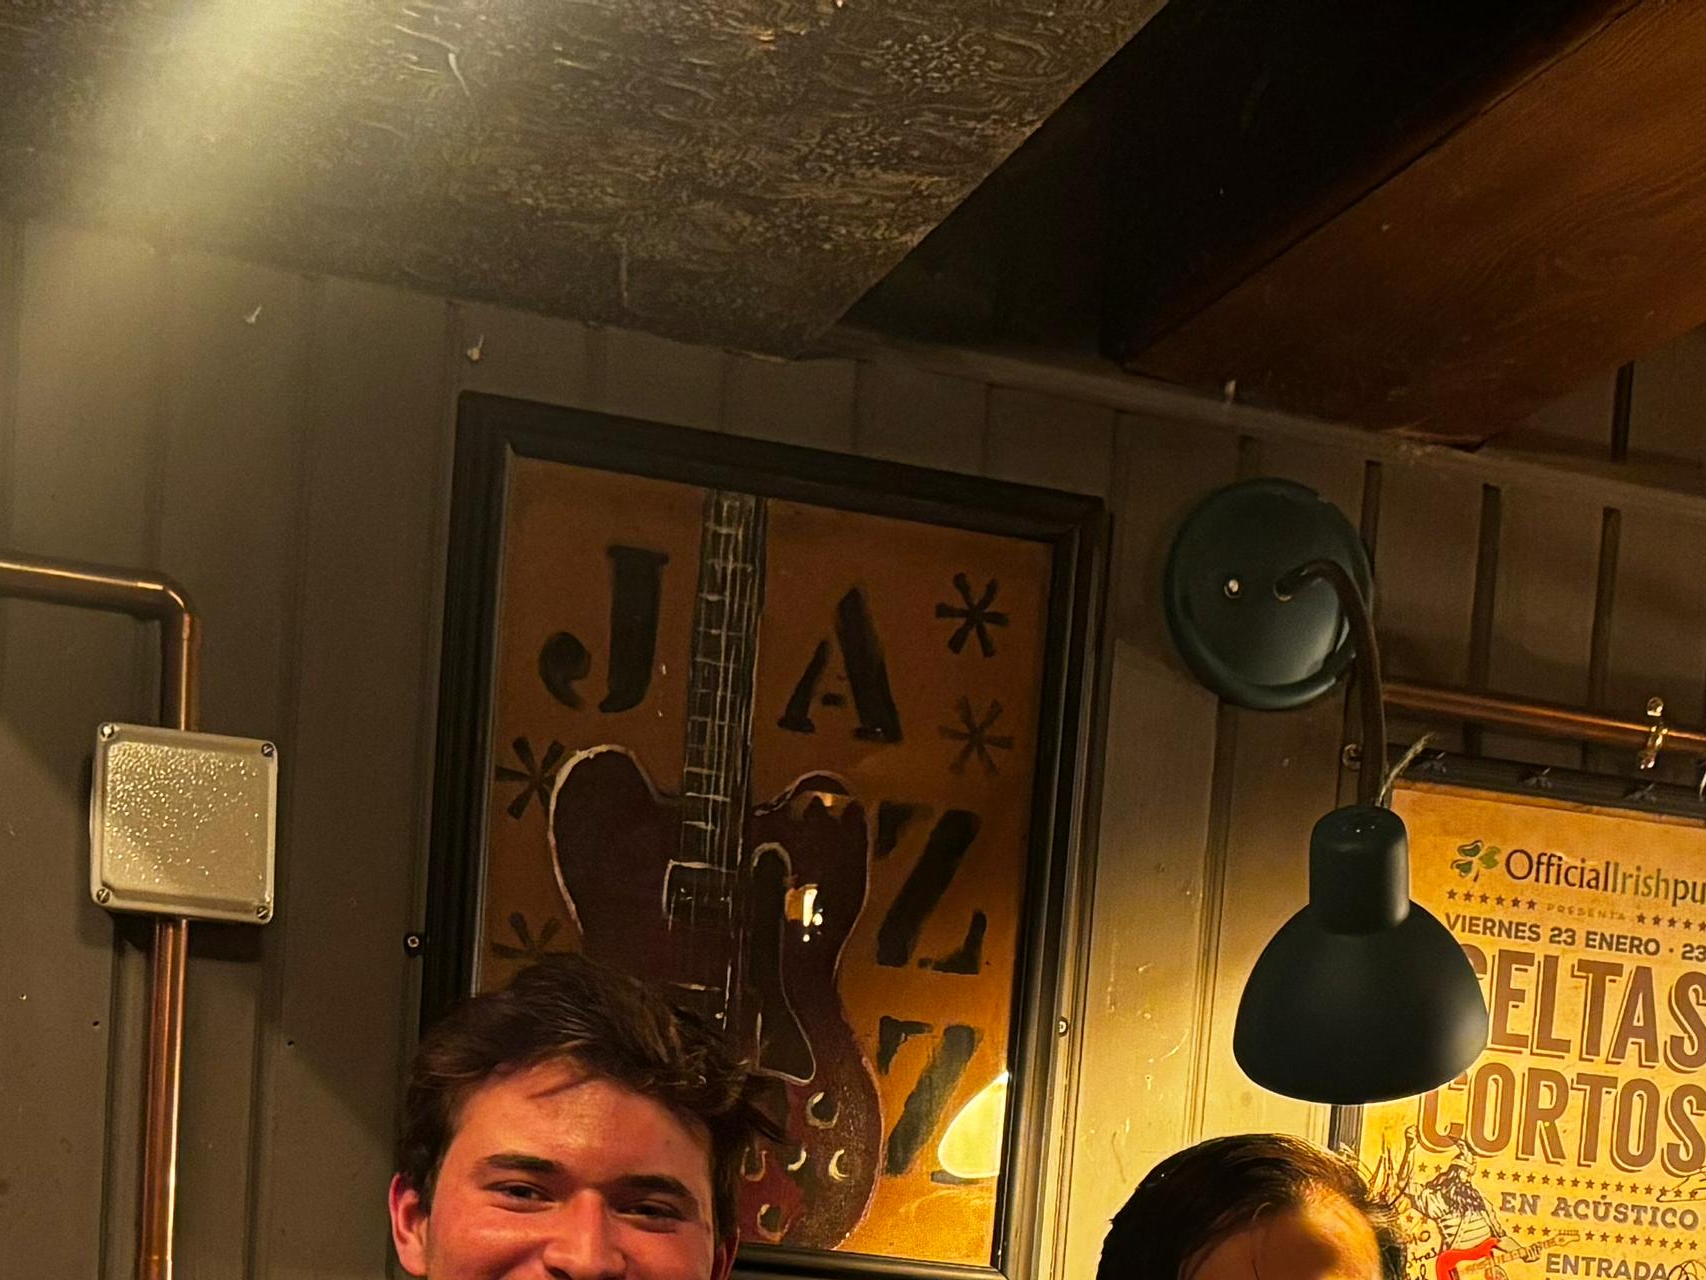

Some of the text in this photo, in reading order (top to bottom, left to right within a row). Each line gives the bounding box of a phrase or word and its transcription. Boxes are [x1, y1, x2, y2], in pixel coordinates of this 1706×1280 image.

[1547, 903, 1626, 921] PRESENTA
[1445, 912, 1541, 942] VIERNES
[1549, 926, 1576, 946] 23
[1585, 931, 1660, 956] ENERO
[1500, 1192, 1699, 1231] EN ACÚSTICO
